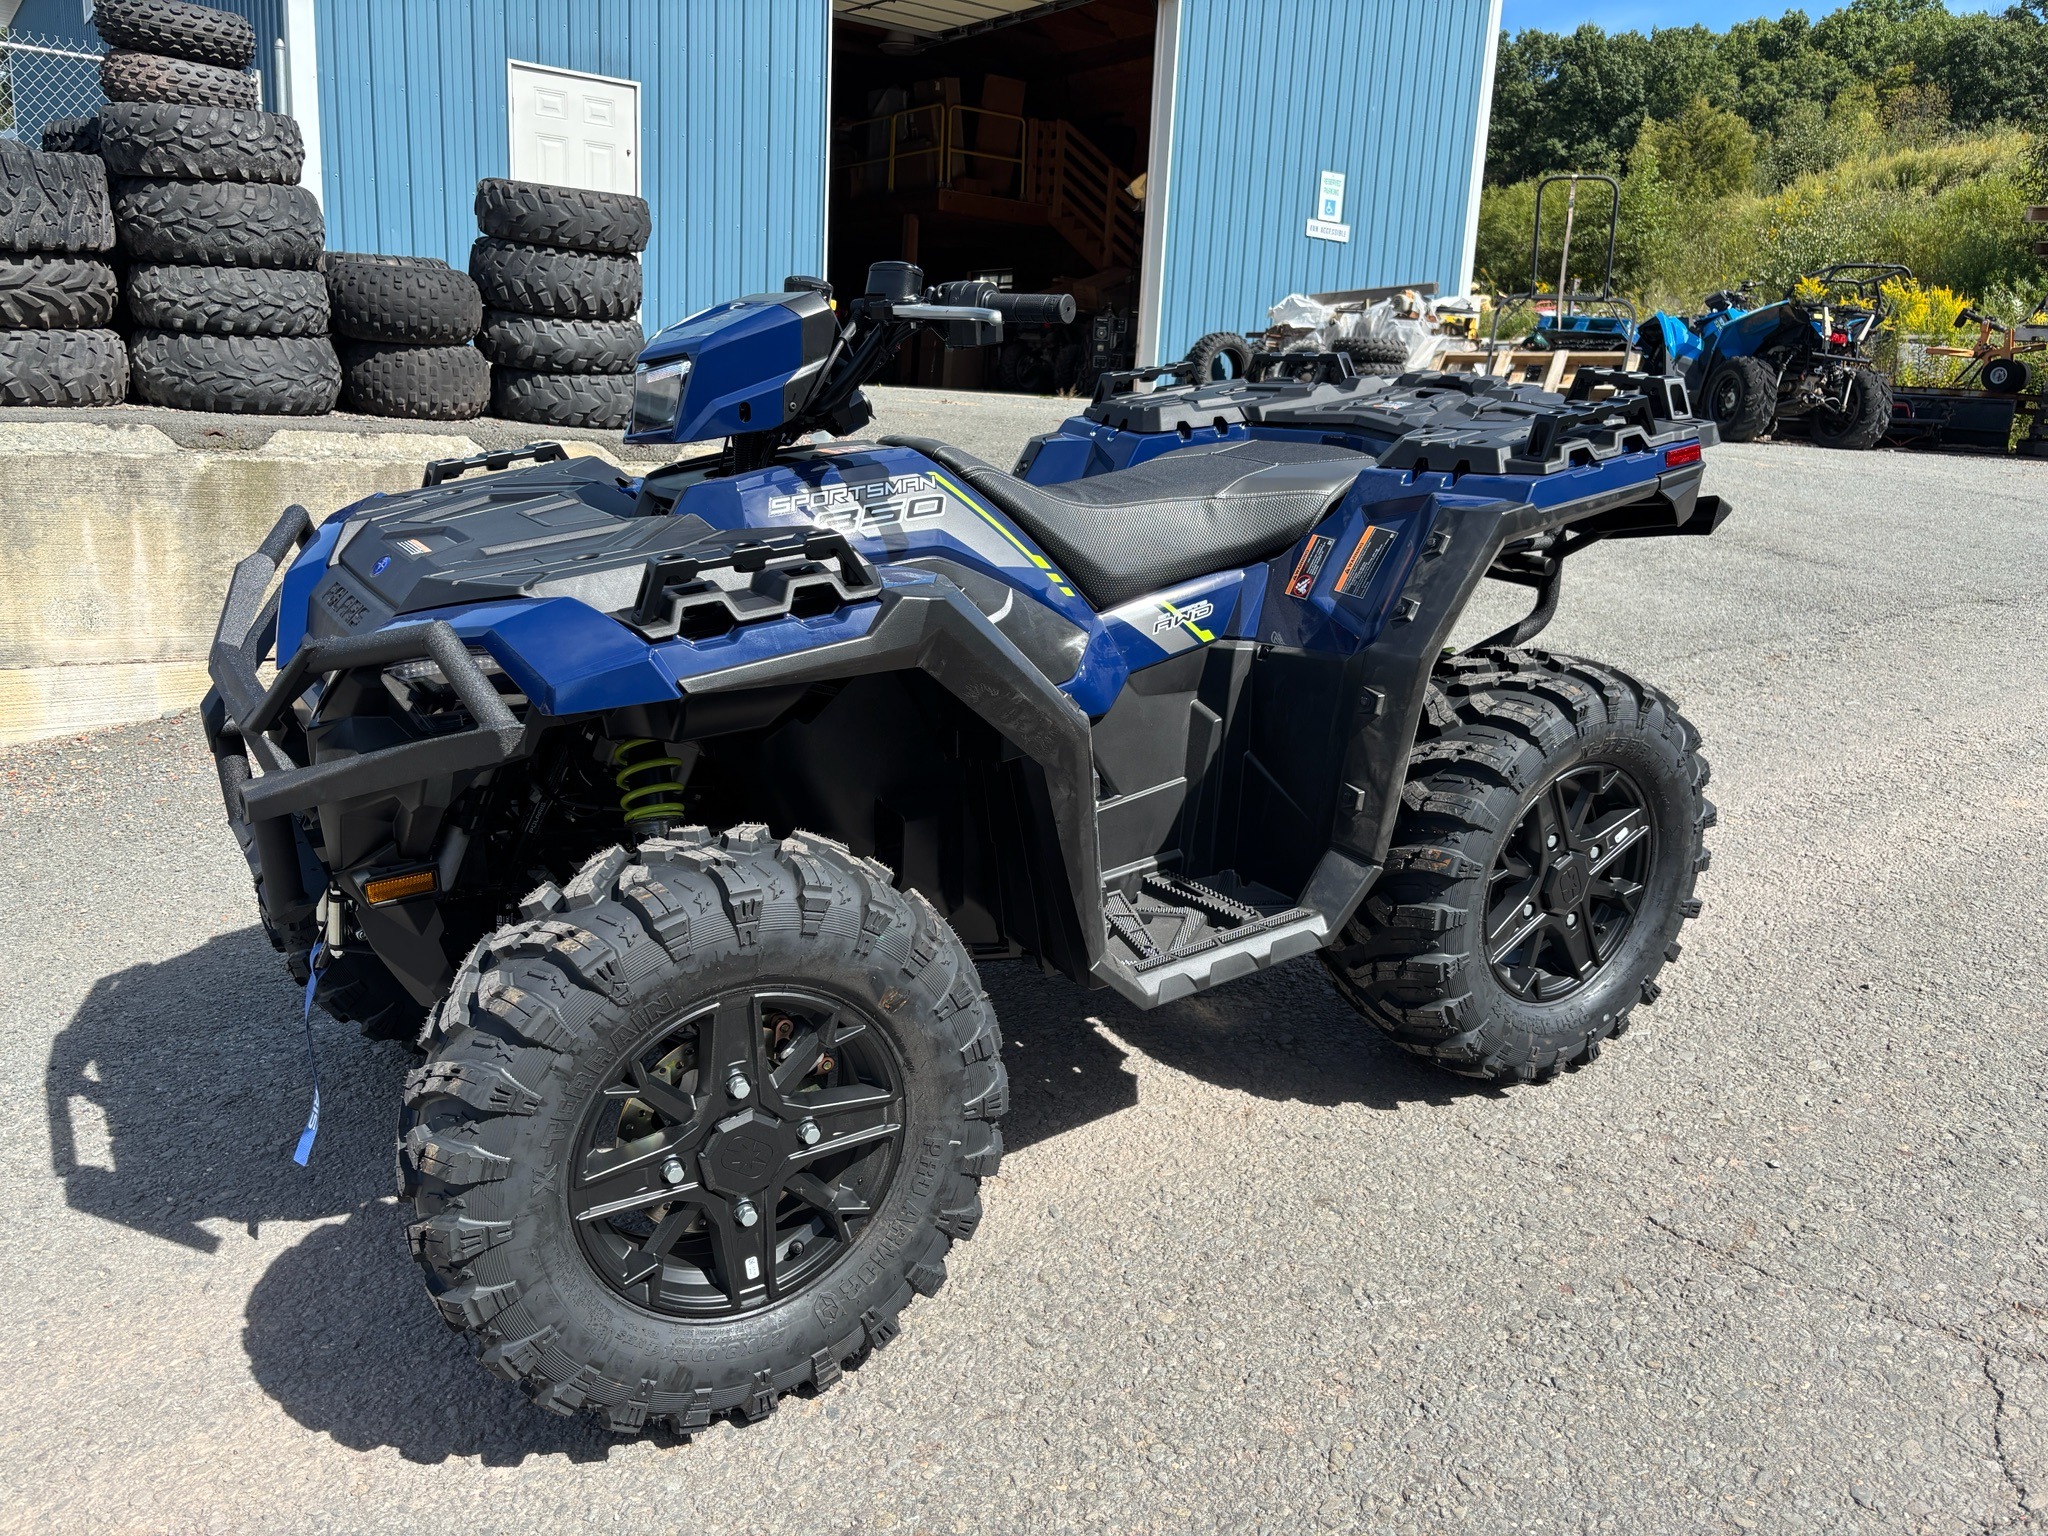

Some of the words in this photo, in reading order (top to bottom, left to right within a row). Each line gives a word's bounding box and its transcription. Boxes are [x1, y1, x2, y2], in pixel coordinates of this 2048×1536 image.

[1320, 227, 1347, 237] ACCESSIBLE
[768, 475, 937, 517] SPORTSMAN
[814, 494, 946, 534] 850
[1295, 549, 1310, 574] WARNING
[1347, 542, 1364, 568] WARNING
[322, 581, 370, 630] POLARIS
[1153, 603, 1213, 635] AWD
[529, 802, 546, 833] POLARIS
[909, 1137, 945, 1198] PRO
[839, 1200, 923, 1301] ARMOR
